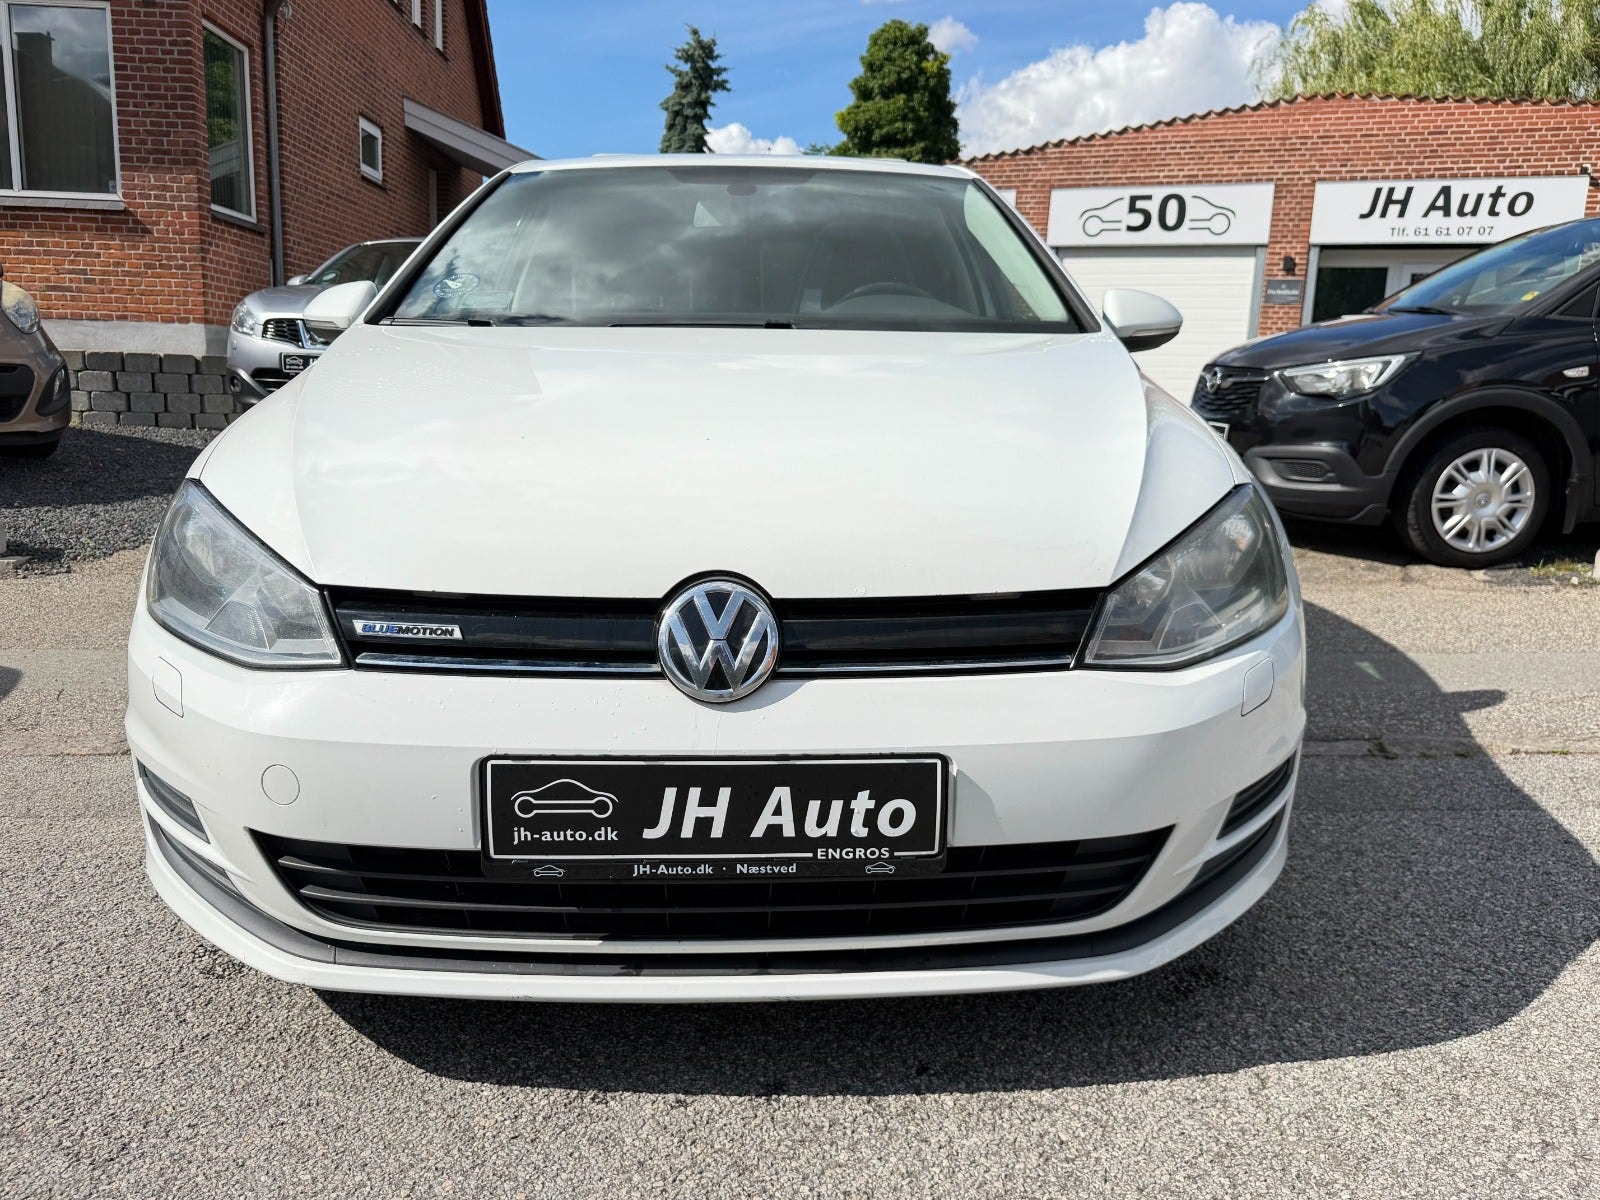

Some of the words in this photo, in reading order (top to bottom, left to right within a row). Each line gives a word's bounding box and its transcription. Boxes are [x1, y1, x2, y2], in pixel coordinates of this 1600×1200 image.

[1358, 186, 1414, 219] JH
[1421, 185, 1535, 218] Auto
[1126, 193, 1187, 232] 50
[1390, 226, 1409, 237] Tlf.
[1414, 226, 1430, 237] 61
[1435, 226, 1452, 237] 61
[1457, 226, 1473, 237] 07
[1478, 226, 1494, 237] 07
[361, 623, 455, 637] BLUEMOTION
[666, 588, 772, 695] VW
[642, 787, 733, 839] JH
[750, 786, 917, 838] Auto
[513, 826, 619, 845] jh-auto.dk
[817, 847, 890, 859] ENGROS
[632, 864, 714, 877] JH-Auto.dk
[736, 863, 797, 874] Næstved
